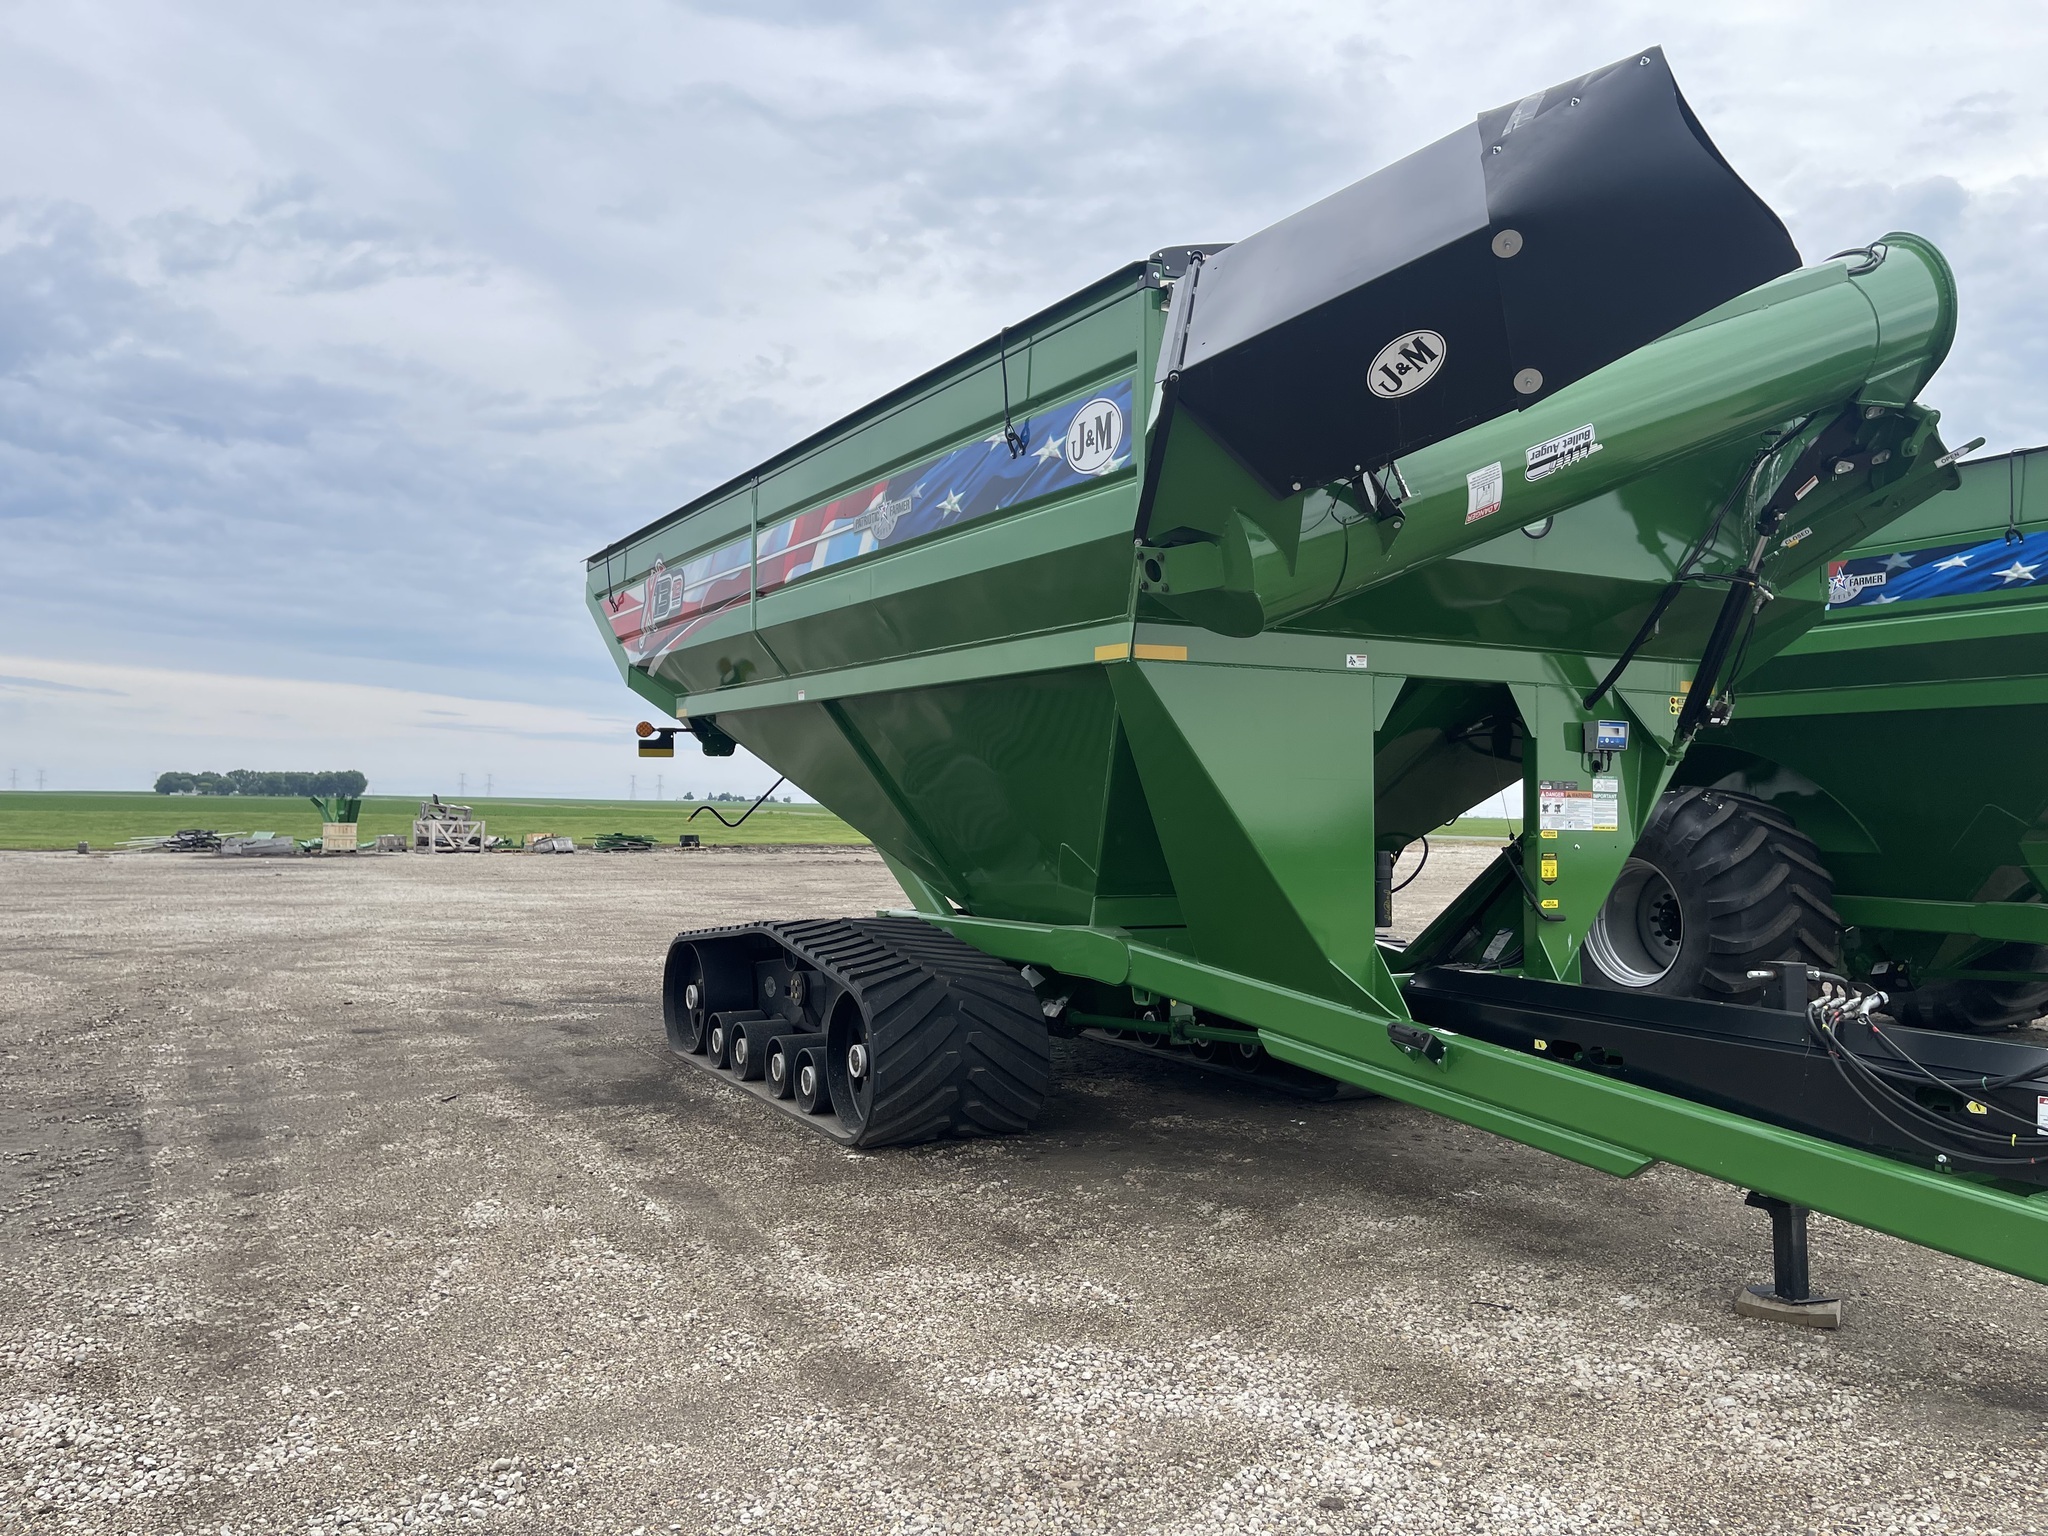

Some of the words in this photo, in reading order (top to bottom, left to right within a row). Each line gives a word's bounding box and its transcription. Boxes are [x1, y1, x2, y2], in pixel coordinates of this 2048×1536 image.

[1378, 335, 1439, 393] J&M
[1071, 410, 1113, 462] J&M
[1563, 429, 1592, 449] Bullet
[1530, 442, 1561, 461] Auger
[1940, 452, 1960, 464] OPEN
[1467, 503, 1494, 521] DANGER
[1849, 574, 1884, 587] FARMER
